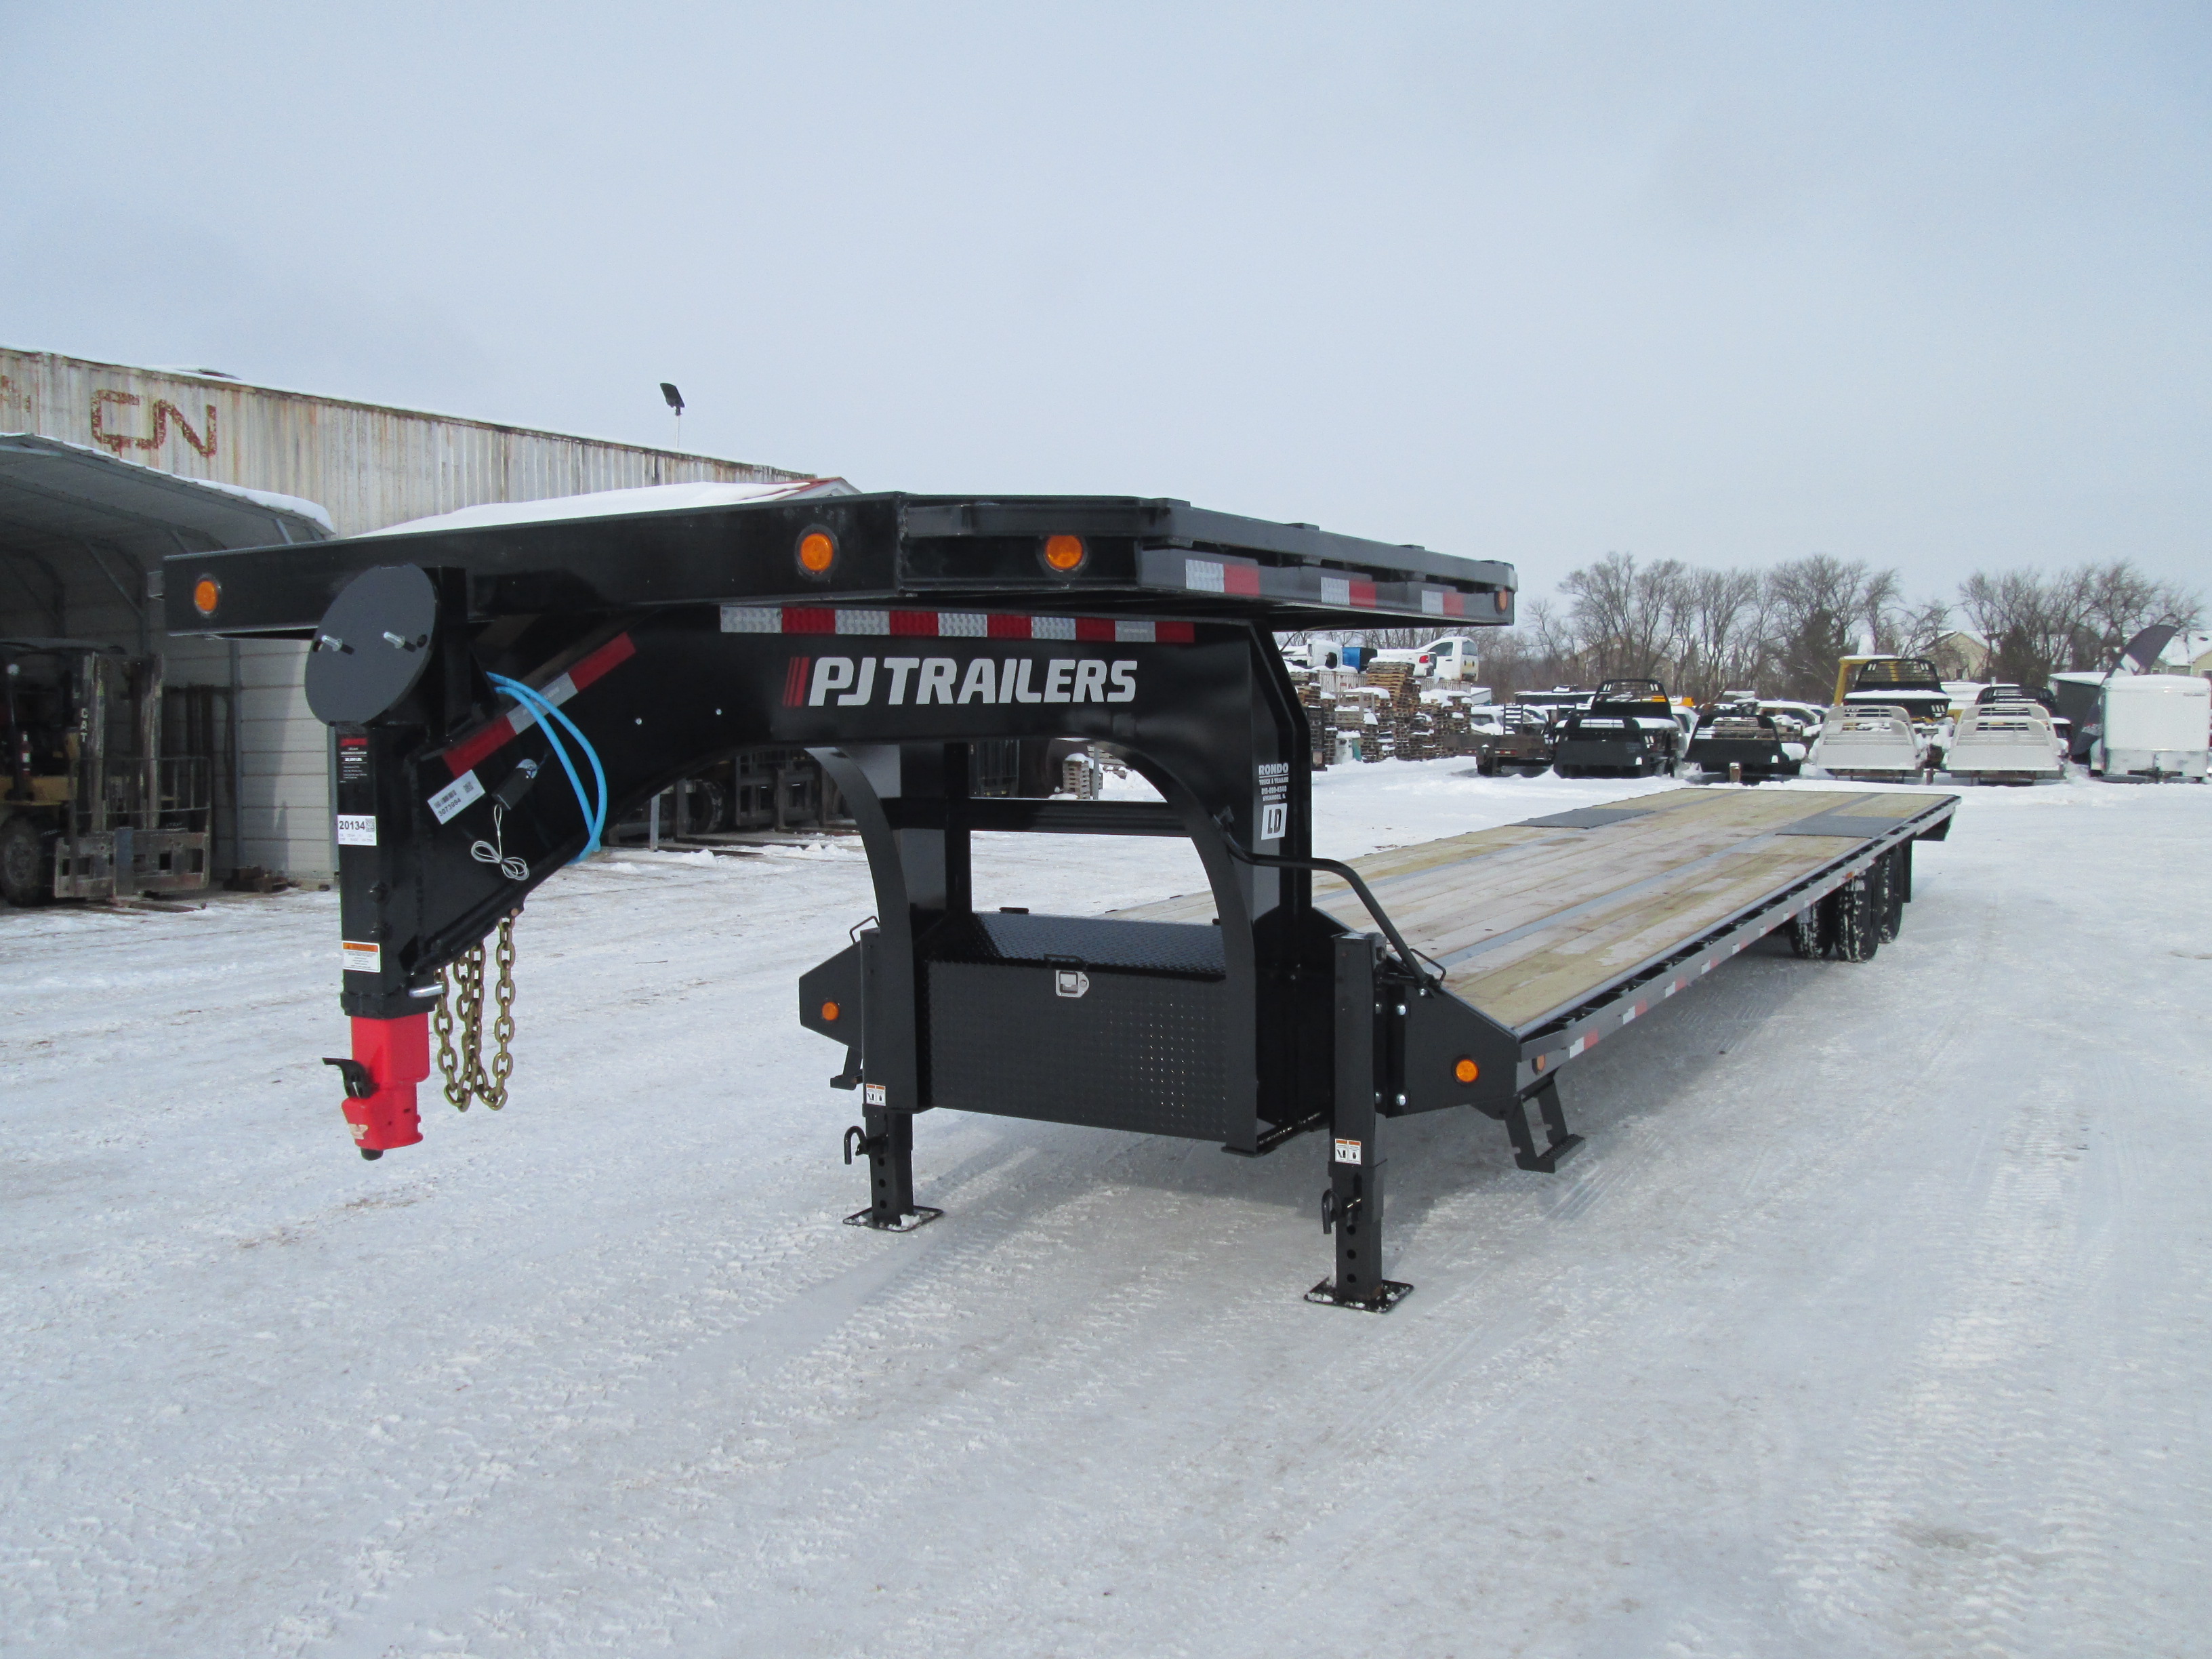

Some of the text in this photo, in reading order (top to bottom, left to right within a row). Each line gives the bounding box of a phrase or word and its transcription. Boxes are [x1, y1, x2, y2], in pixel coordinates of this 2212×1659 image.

[808, 656, 1139, 706] PJ TRAILERS
[80, 708, 88, 743] CAT
[1258, 762, 1289, 775] RONDO
[339, 820, 365, 830] 20134
